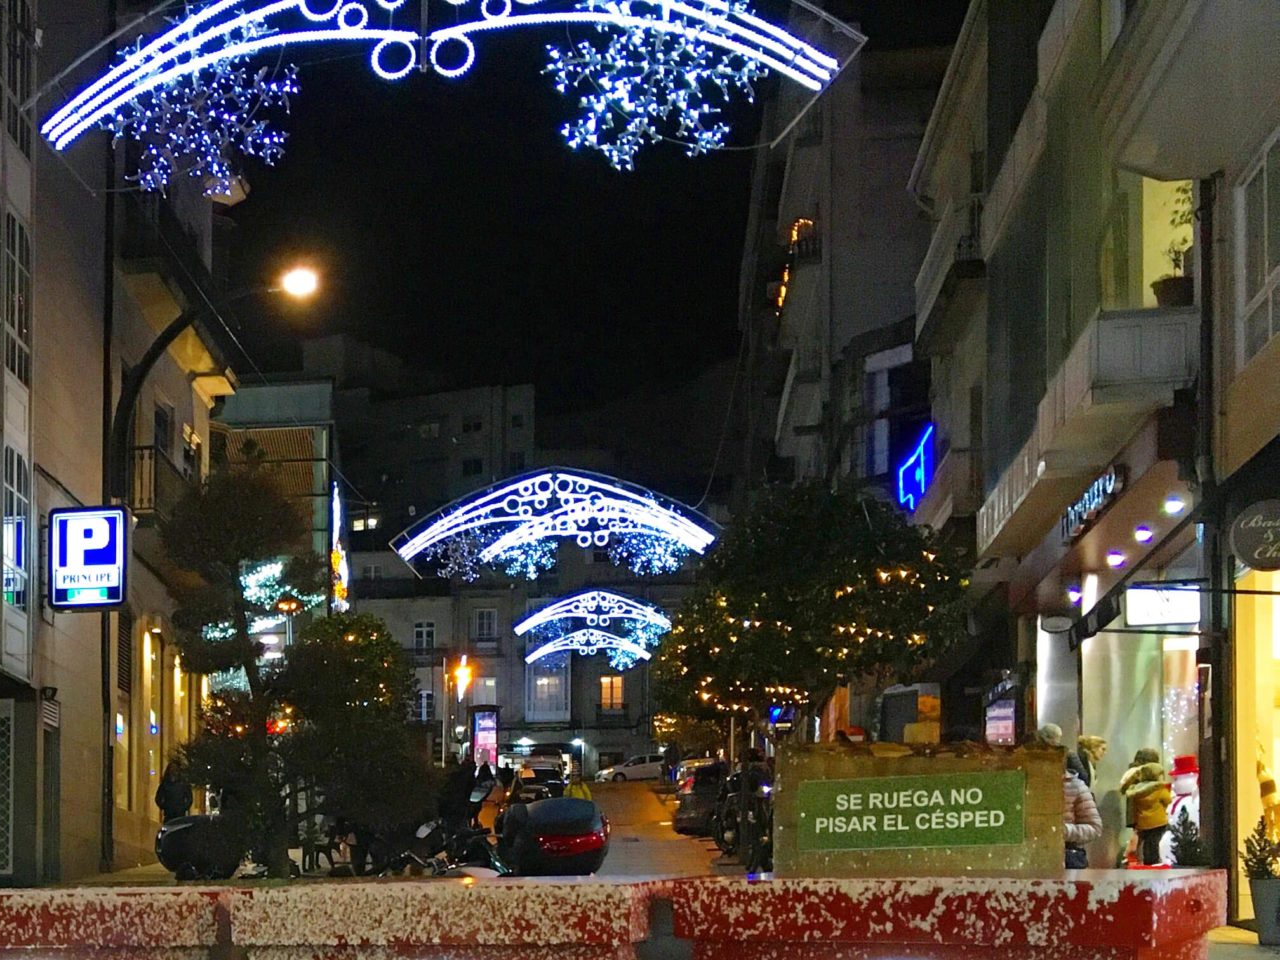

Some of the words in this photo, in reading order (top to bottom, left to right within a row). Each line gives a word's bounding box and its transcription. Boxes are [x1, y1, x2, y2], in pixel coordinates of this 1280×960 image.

[67, 518, 110, 567] P
[62, 572, 113, 585] PRINCIPE
[836, 793, 862, 811] SE
[868, 790, 945, 809] RUEGA
[951, 788, 983, 805] NO
[815, 815, 877, 833] PISAR
[883, 814, 910, 831] EL
[915, 809, 1005, 829] CÉSPED
